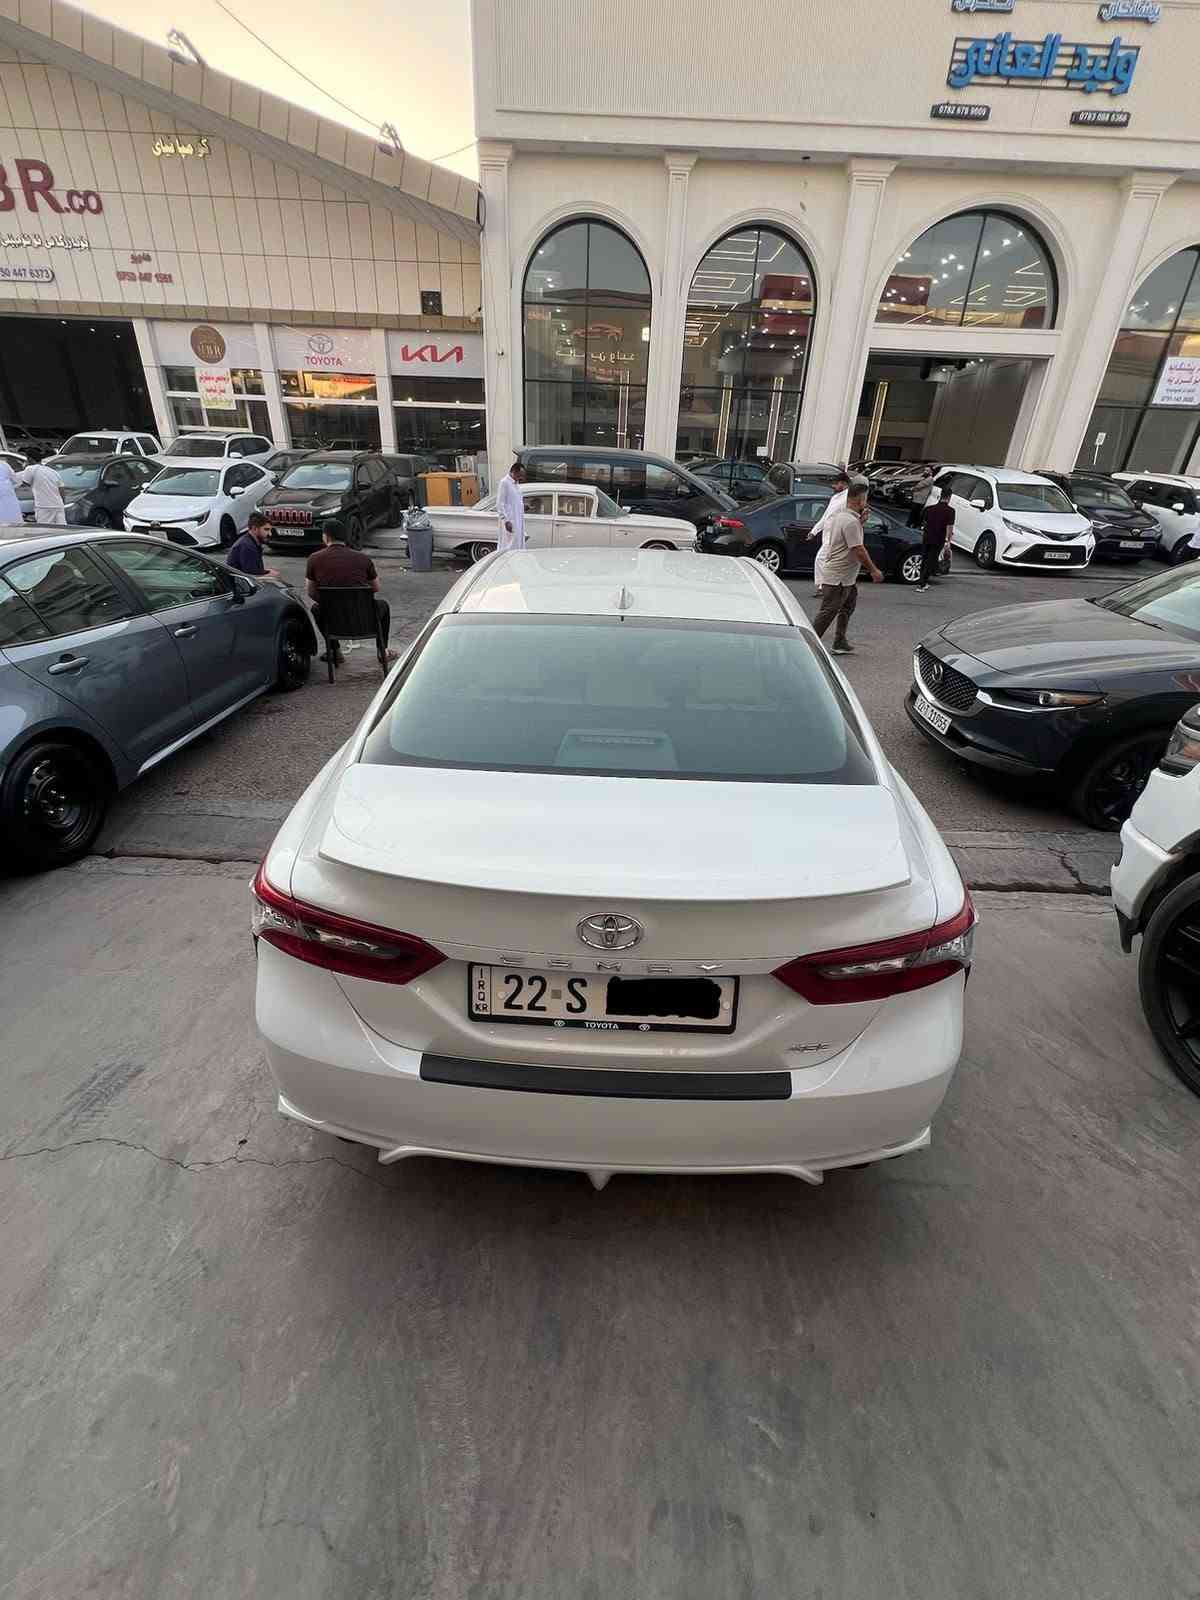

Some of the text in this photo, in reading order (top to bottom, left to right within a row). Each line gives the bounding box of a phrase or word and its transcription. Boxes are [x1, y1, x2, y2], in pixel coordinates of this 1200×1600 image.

[304, 355, 343, 367] TOYOTA
[401, 344, 464, 364] KIA
[503, 973, 588, 1014] 22 S
[584, 1021, 620, 1030] TOYOTA
